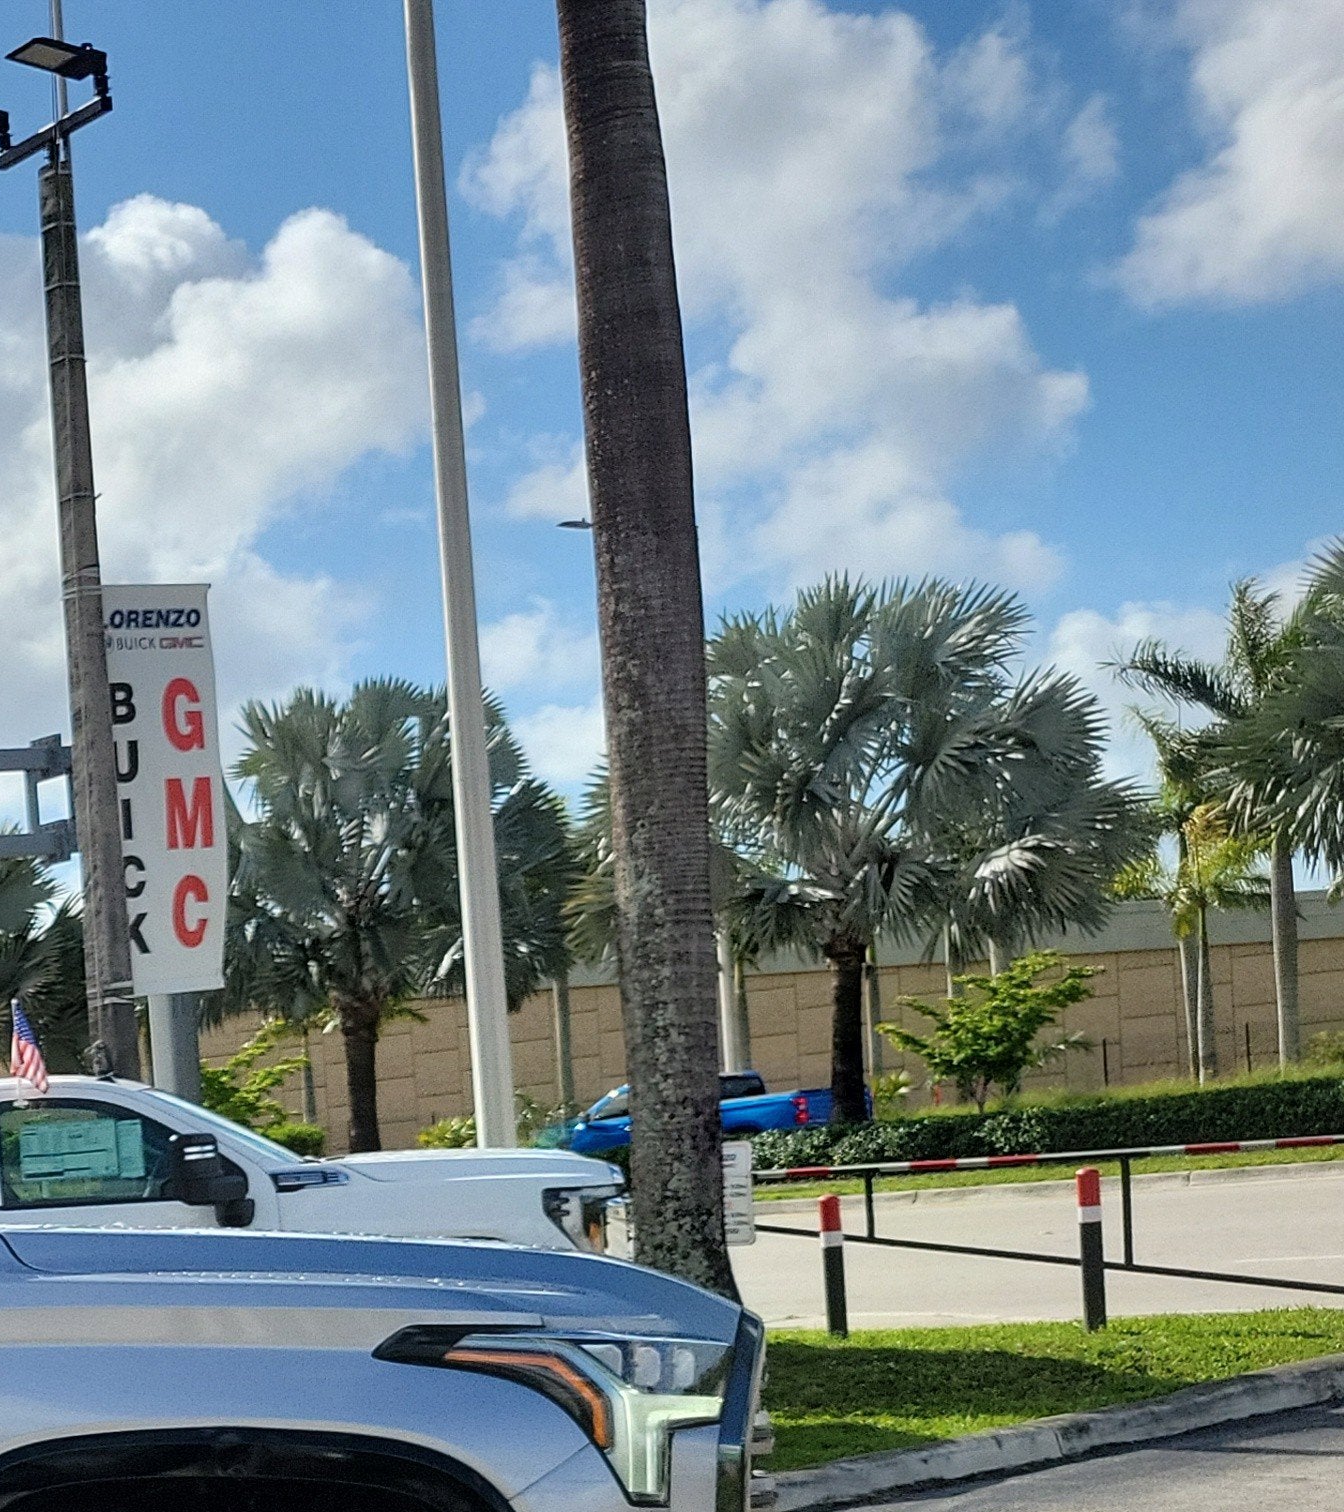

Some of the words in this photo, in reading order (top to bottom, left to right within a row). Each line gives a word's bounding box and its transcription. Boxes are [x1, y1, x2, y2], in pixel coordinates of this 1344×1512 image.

[103, 609, 201, 629] ORENZO
[116, 637, 157, 651] BUICK
[159, 636, 204, 649] GMC
[109, 682, 151, 955] BUICK
[161, 677, 215, 949] GMC
